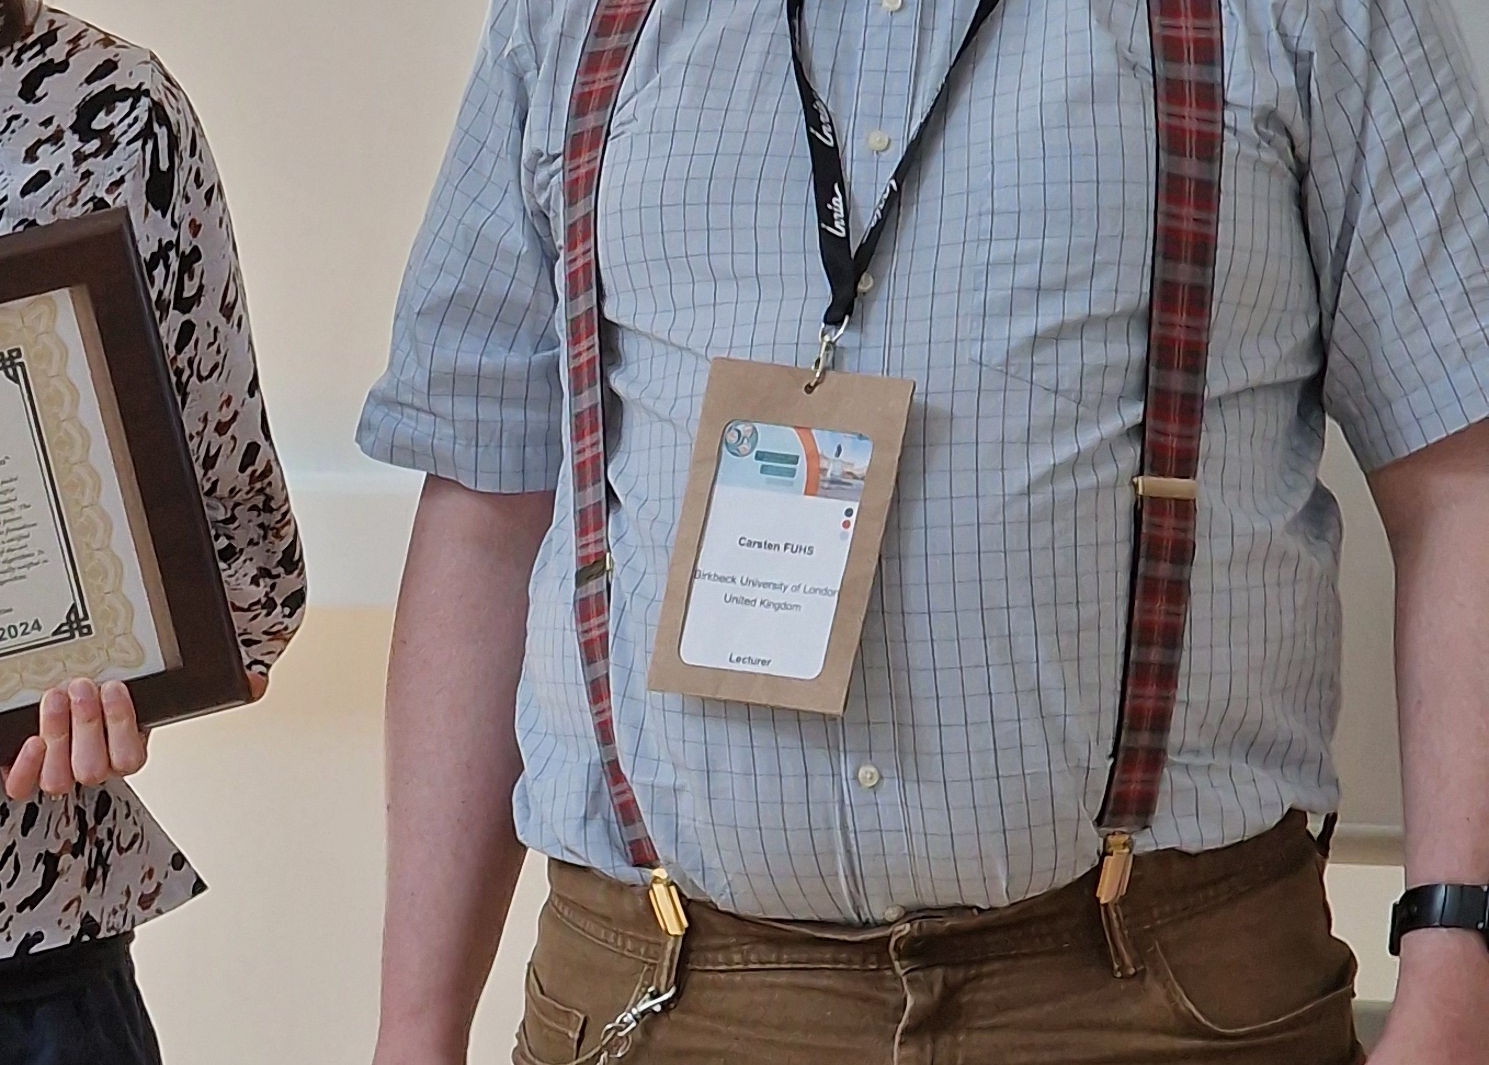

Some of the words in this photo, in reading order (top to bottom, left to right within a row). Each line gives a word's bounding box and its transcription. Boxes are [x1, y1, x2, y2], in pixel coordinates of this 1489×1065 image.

[821, 182, 846, 238] Inria
[738, 536, 781, 552] Carsten
[783, 542, 815, 556] FUHS
[740, 576, 790, 593] University
[791, 582, 801, 593] of
[723, 593, 757, 608] United
[759, 598, 802, 612] Kingdom
[728, 652, 773, 667] Lecturer
